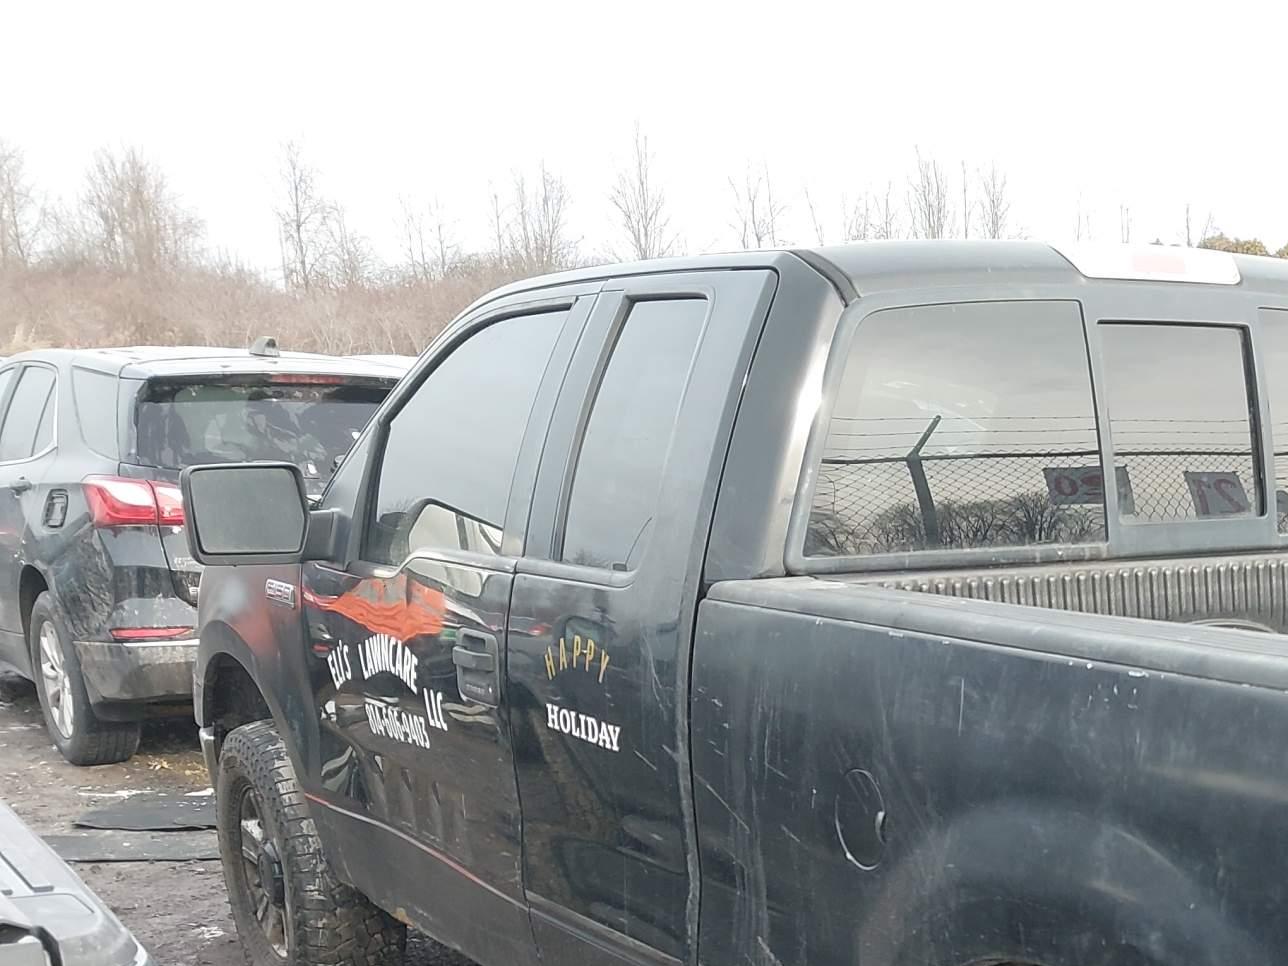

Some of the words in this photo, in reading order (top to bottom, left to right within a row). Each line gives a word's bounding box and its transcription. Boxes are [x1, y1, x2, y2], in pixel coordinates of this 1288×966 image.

[544, 634, 610, 684] HAPPY
[327, 639, 352, 690] ELI'S
[423, 687, 449, 732] LLC
[545, 703, 621, 752] HOLIDAY
